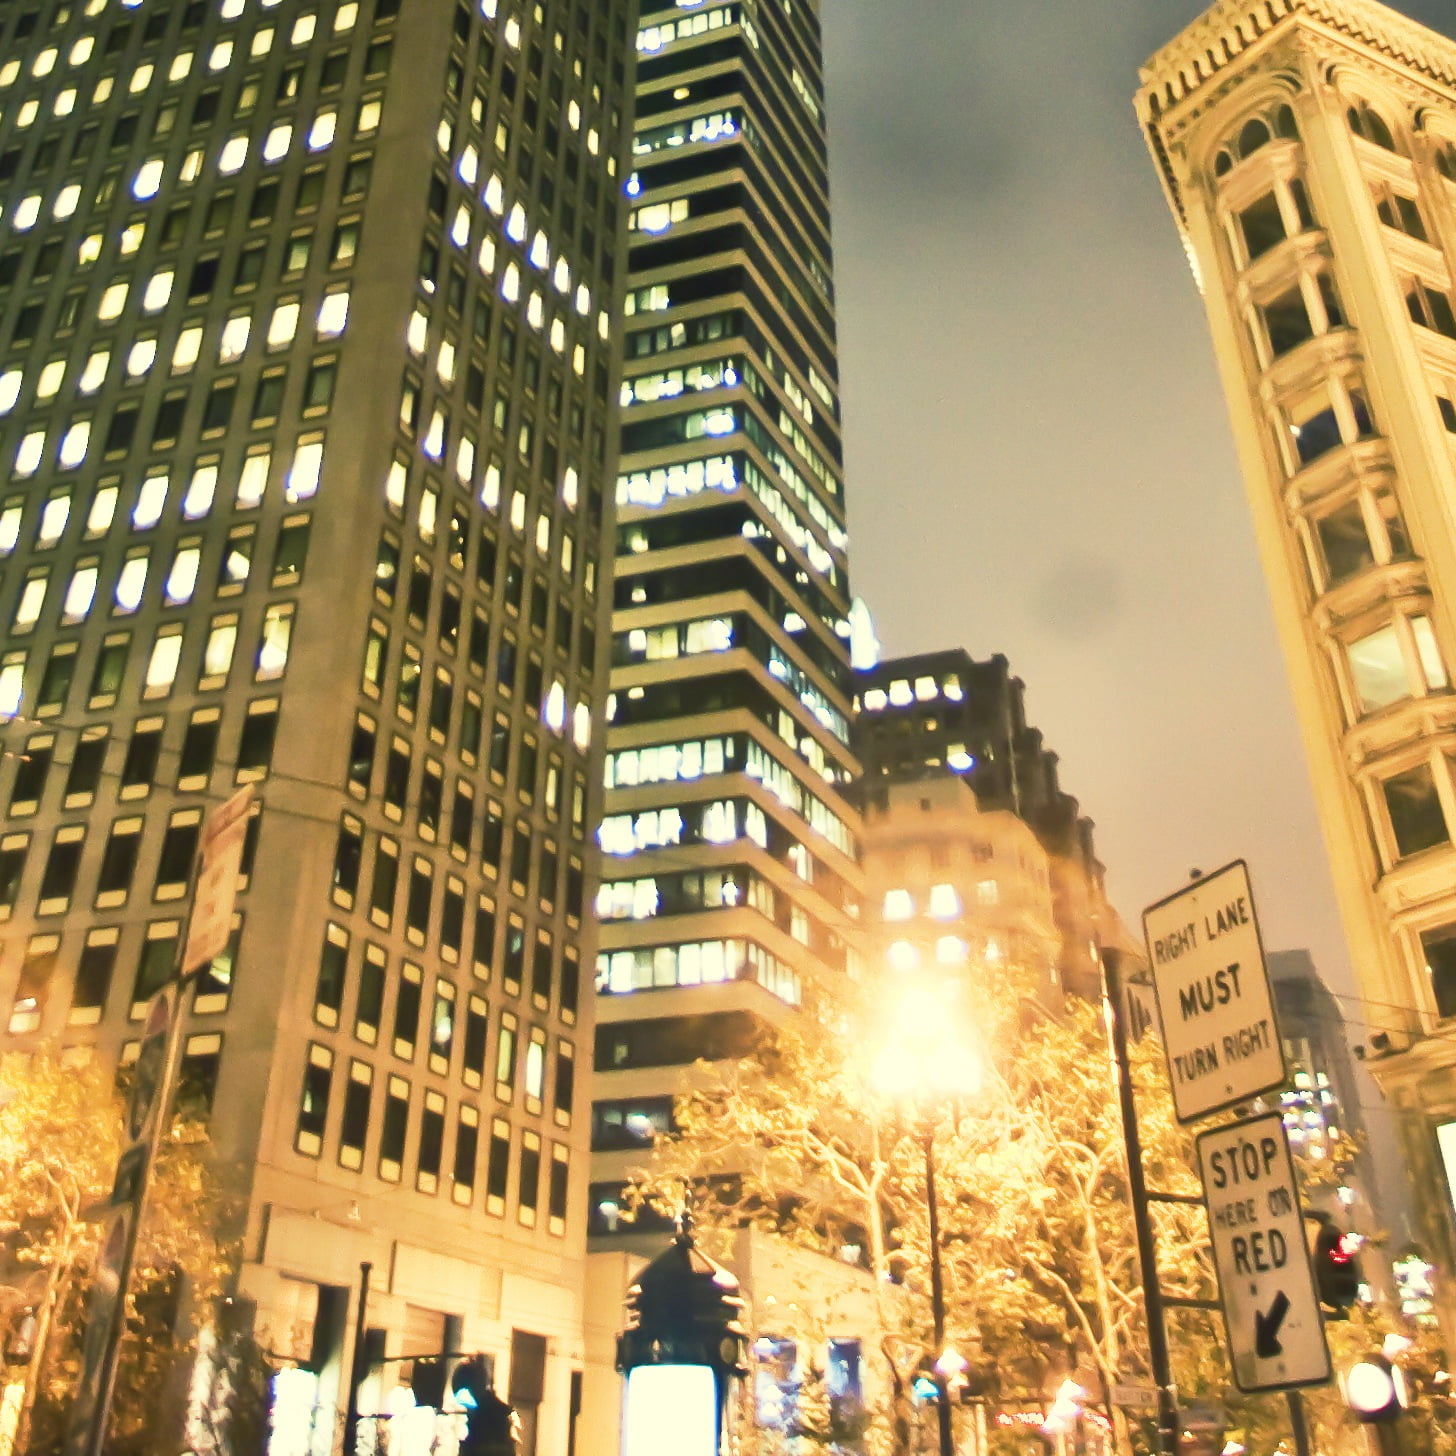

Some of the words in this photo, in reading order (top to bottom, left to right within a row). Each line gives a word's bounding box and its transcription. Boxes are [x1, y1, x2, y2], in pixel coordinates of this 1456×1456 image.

[1154, 923, 1198, 964] RIGHT
[1205, 897, 1249, 941] LANE
[1179, 963, 1241, 1022] MUST
[1174, 1042, 1220, 1084] TURN
[1222, 1019, 1271, 1066] RIGHT
[1210, 1137, 1277, 1189] STOP
[1215, 1198, 1257, 1228] HERE
[1267, 1185, 1292, 1217] ON
[1232, 1228, 1288, 1276] RED
